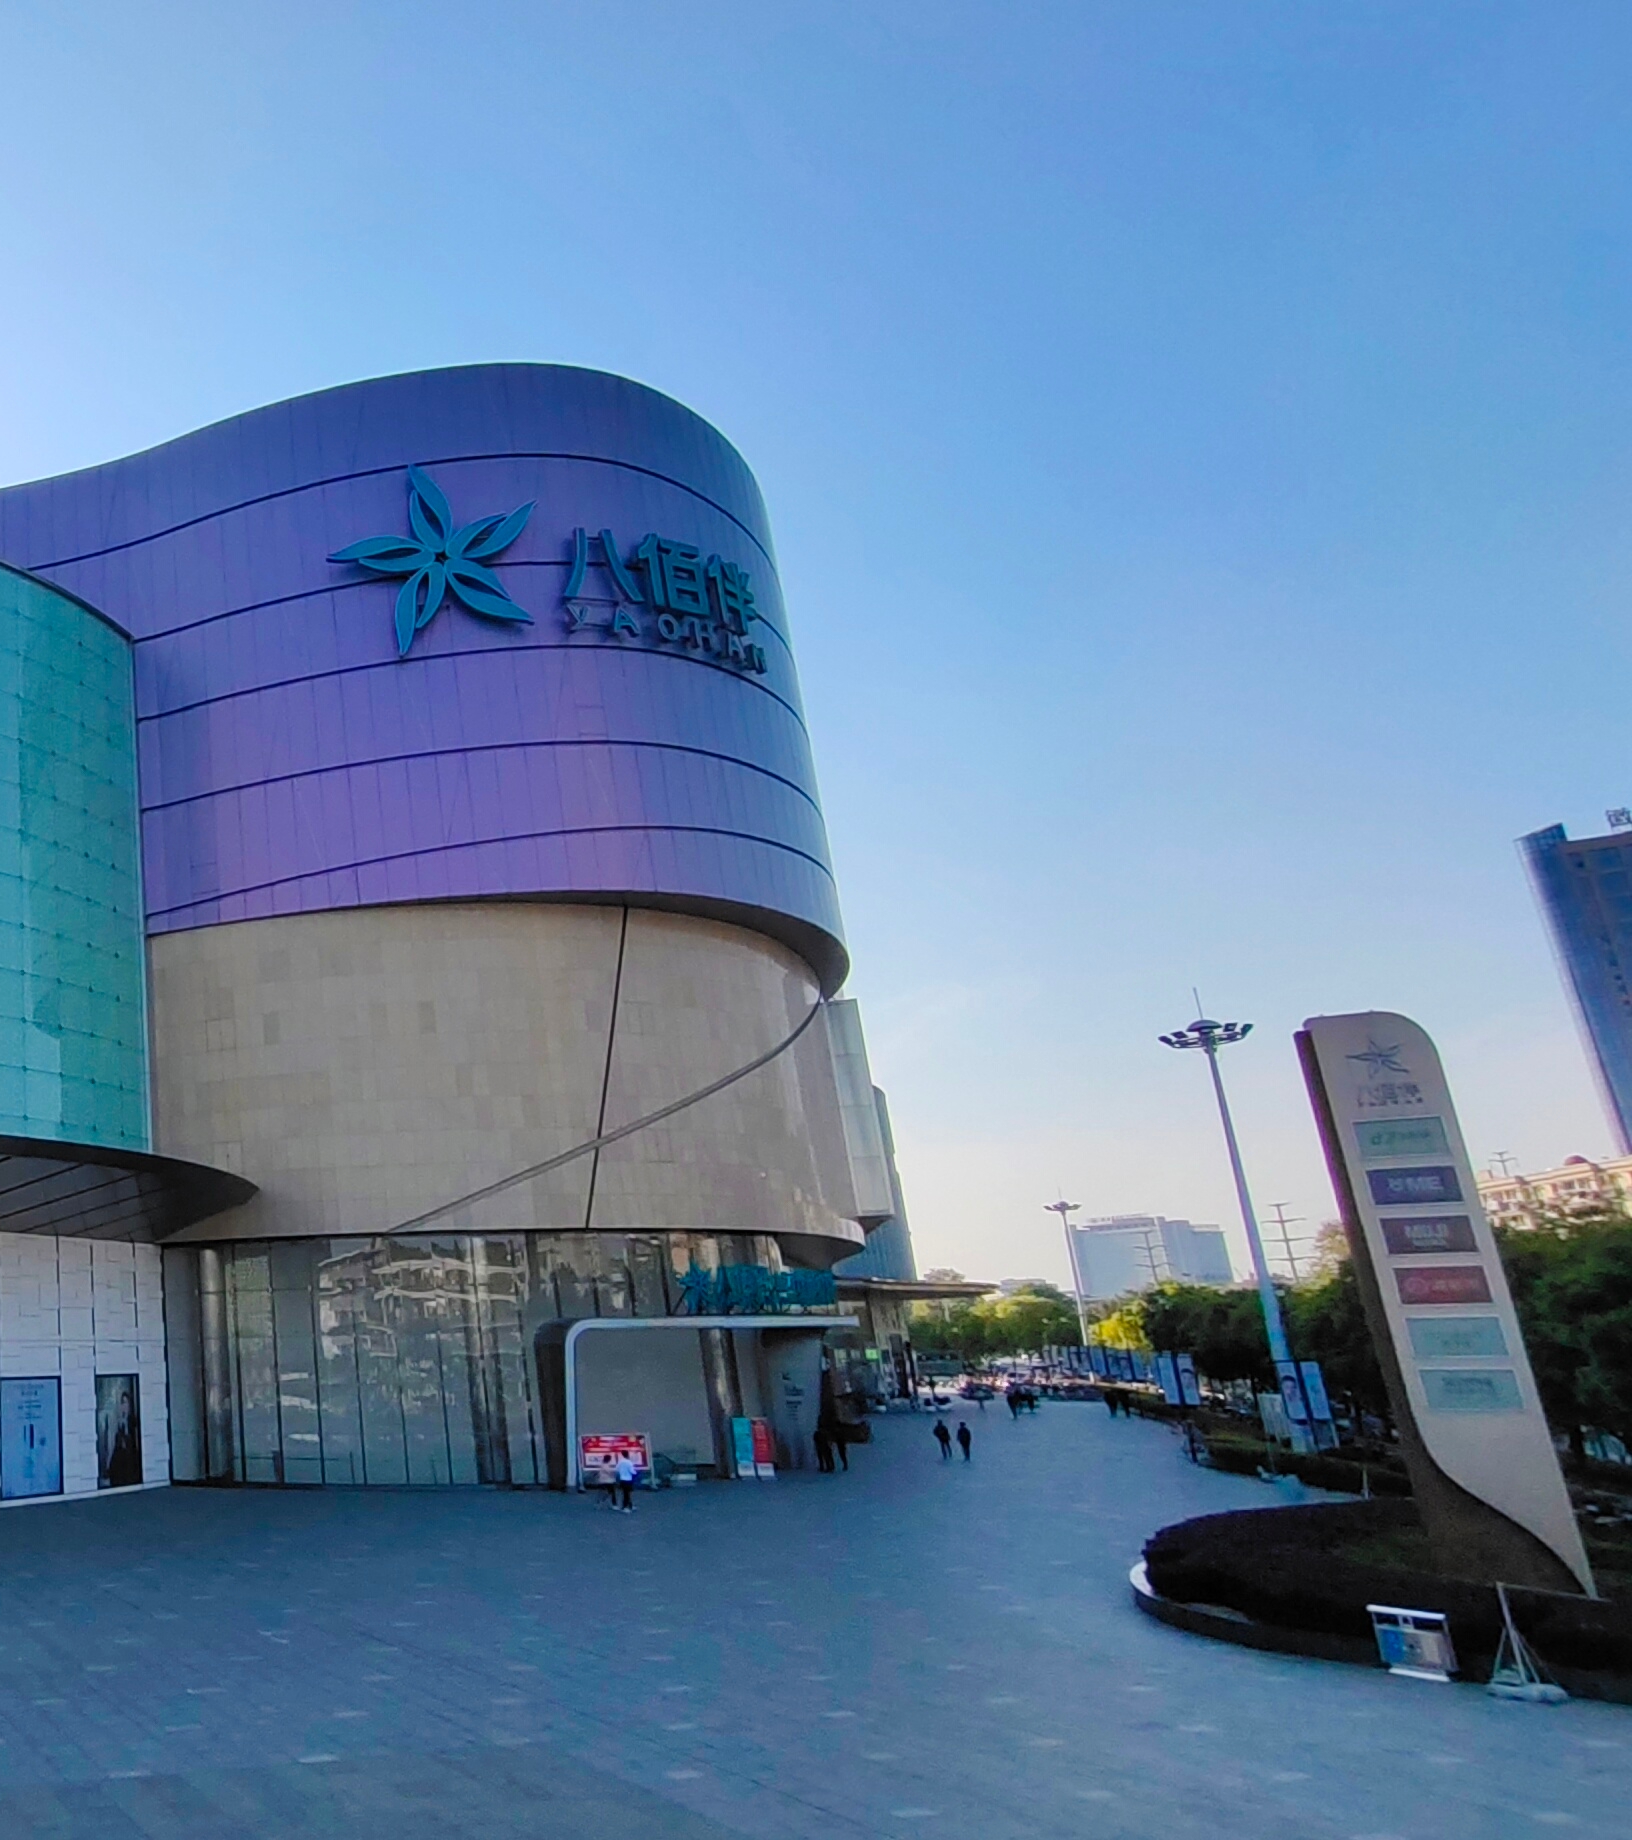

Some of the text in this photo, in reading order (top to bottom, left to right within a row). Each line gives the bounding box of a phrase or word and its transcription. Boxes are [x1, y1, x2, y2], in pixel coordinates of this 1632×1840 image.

[563, 527, 757, 636] 八佰伴
[566, 602, 768, 675] YAOHAN
